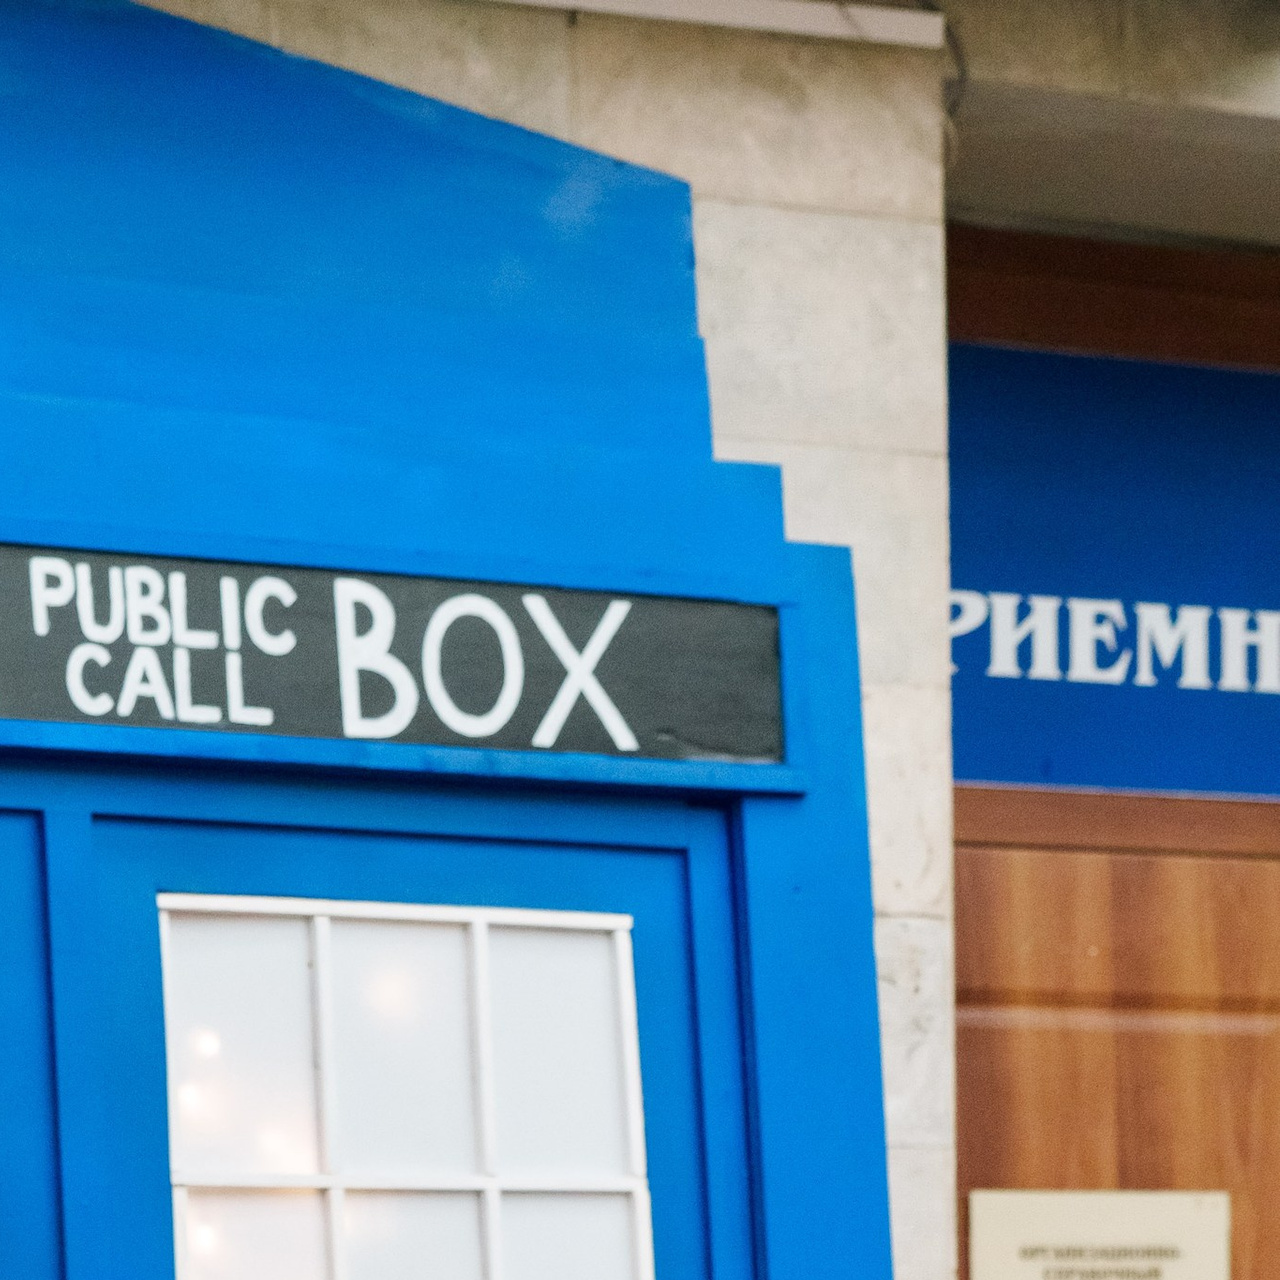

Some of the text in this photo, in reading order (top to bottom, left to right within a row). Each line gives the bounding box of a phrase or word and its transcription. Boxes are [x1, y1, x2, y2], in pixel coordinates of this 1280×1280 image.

[29, 556, 297, 657] PUBLIC
[66, 643, 275, 726] CALL
[333, 577, 639, 751] BOX
